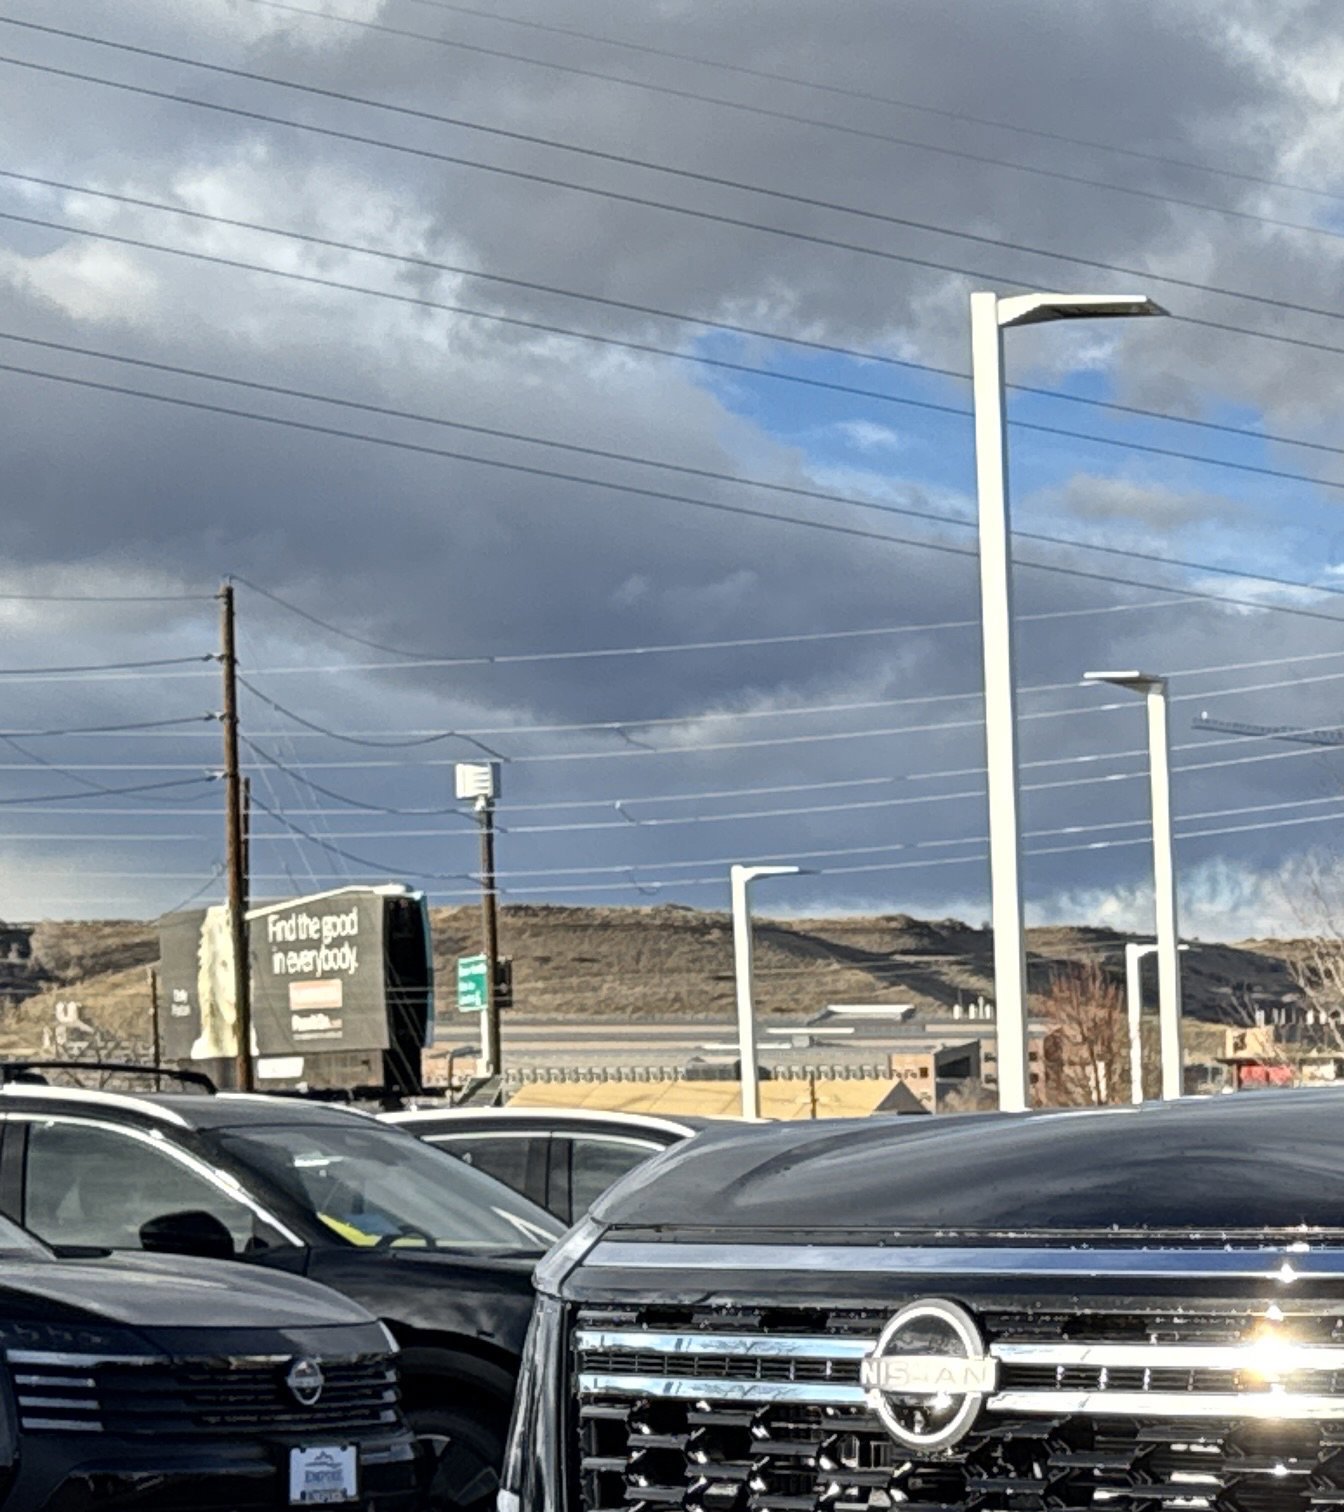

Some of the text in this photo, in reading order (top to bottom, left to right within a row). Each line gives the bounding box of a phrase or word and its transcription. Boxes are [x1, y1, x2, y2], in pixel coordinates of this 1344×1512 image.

[268, 906, 359, 944] Find the good
[272, 946, 287, 974] in
[861, 1360, 988, 1385] NISAN
